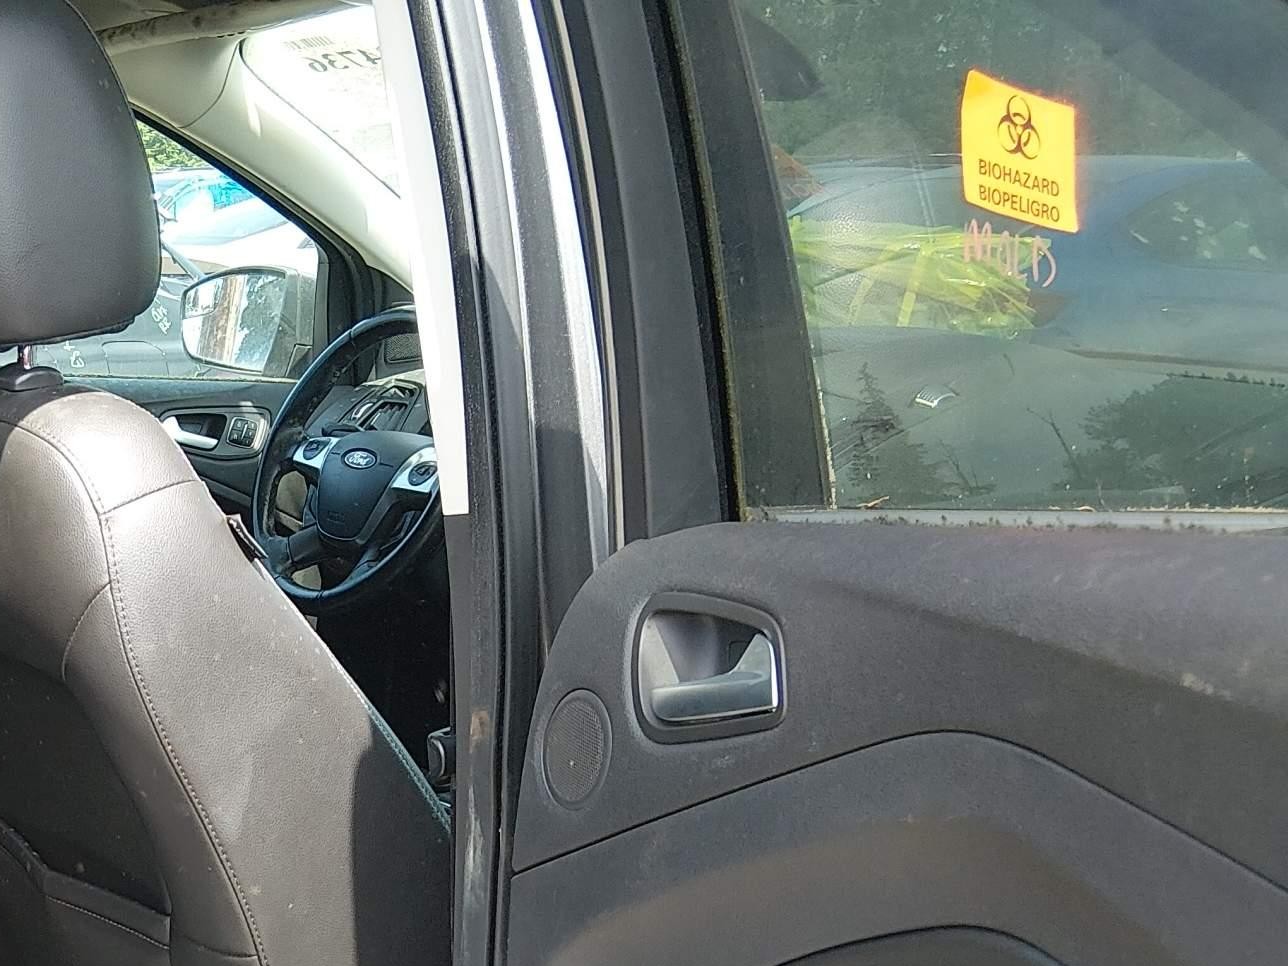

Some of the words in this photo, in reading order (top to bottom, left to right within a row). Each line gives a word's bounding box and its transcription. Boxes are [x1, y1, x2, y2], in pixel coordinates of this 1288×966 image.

[978, 158, 1060, 197] BIOHAZARD
[978, 184, 1060, 223] BIOPELIGRO
[348, 451, 373, 466] Ford
